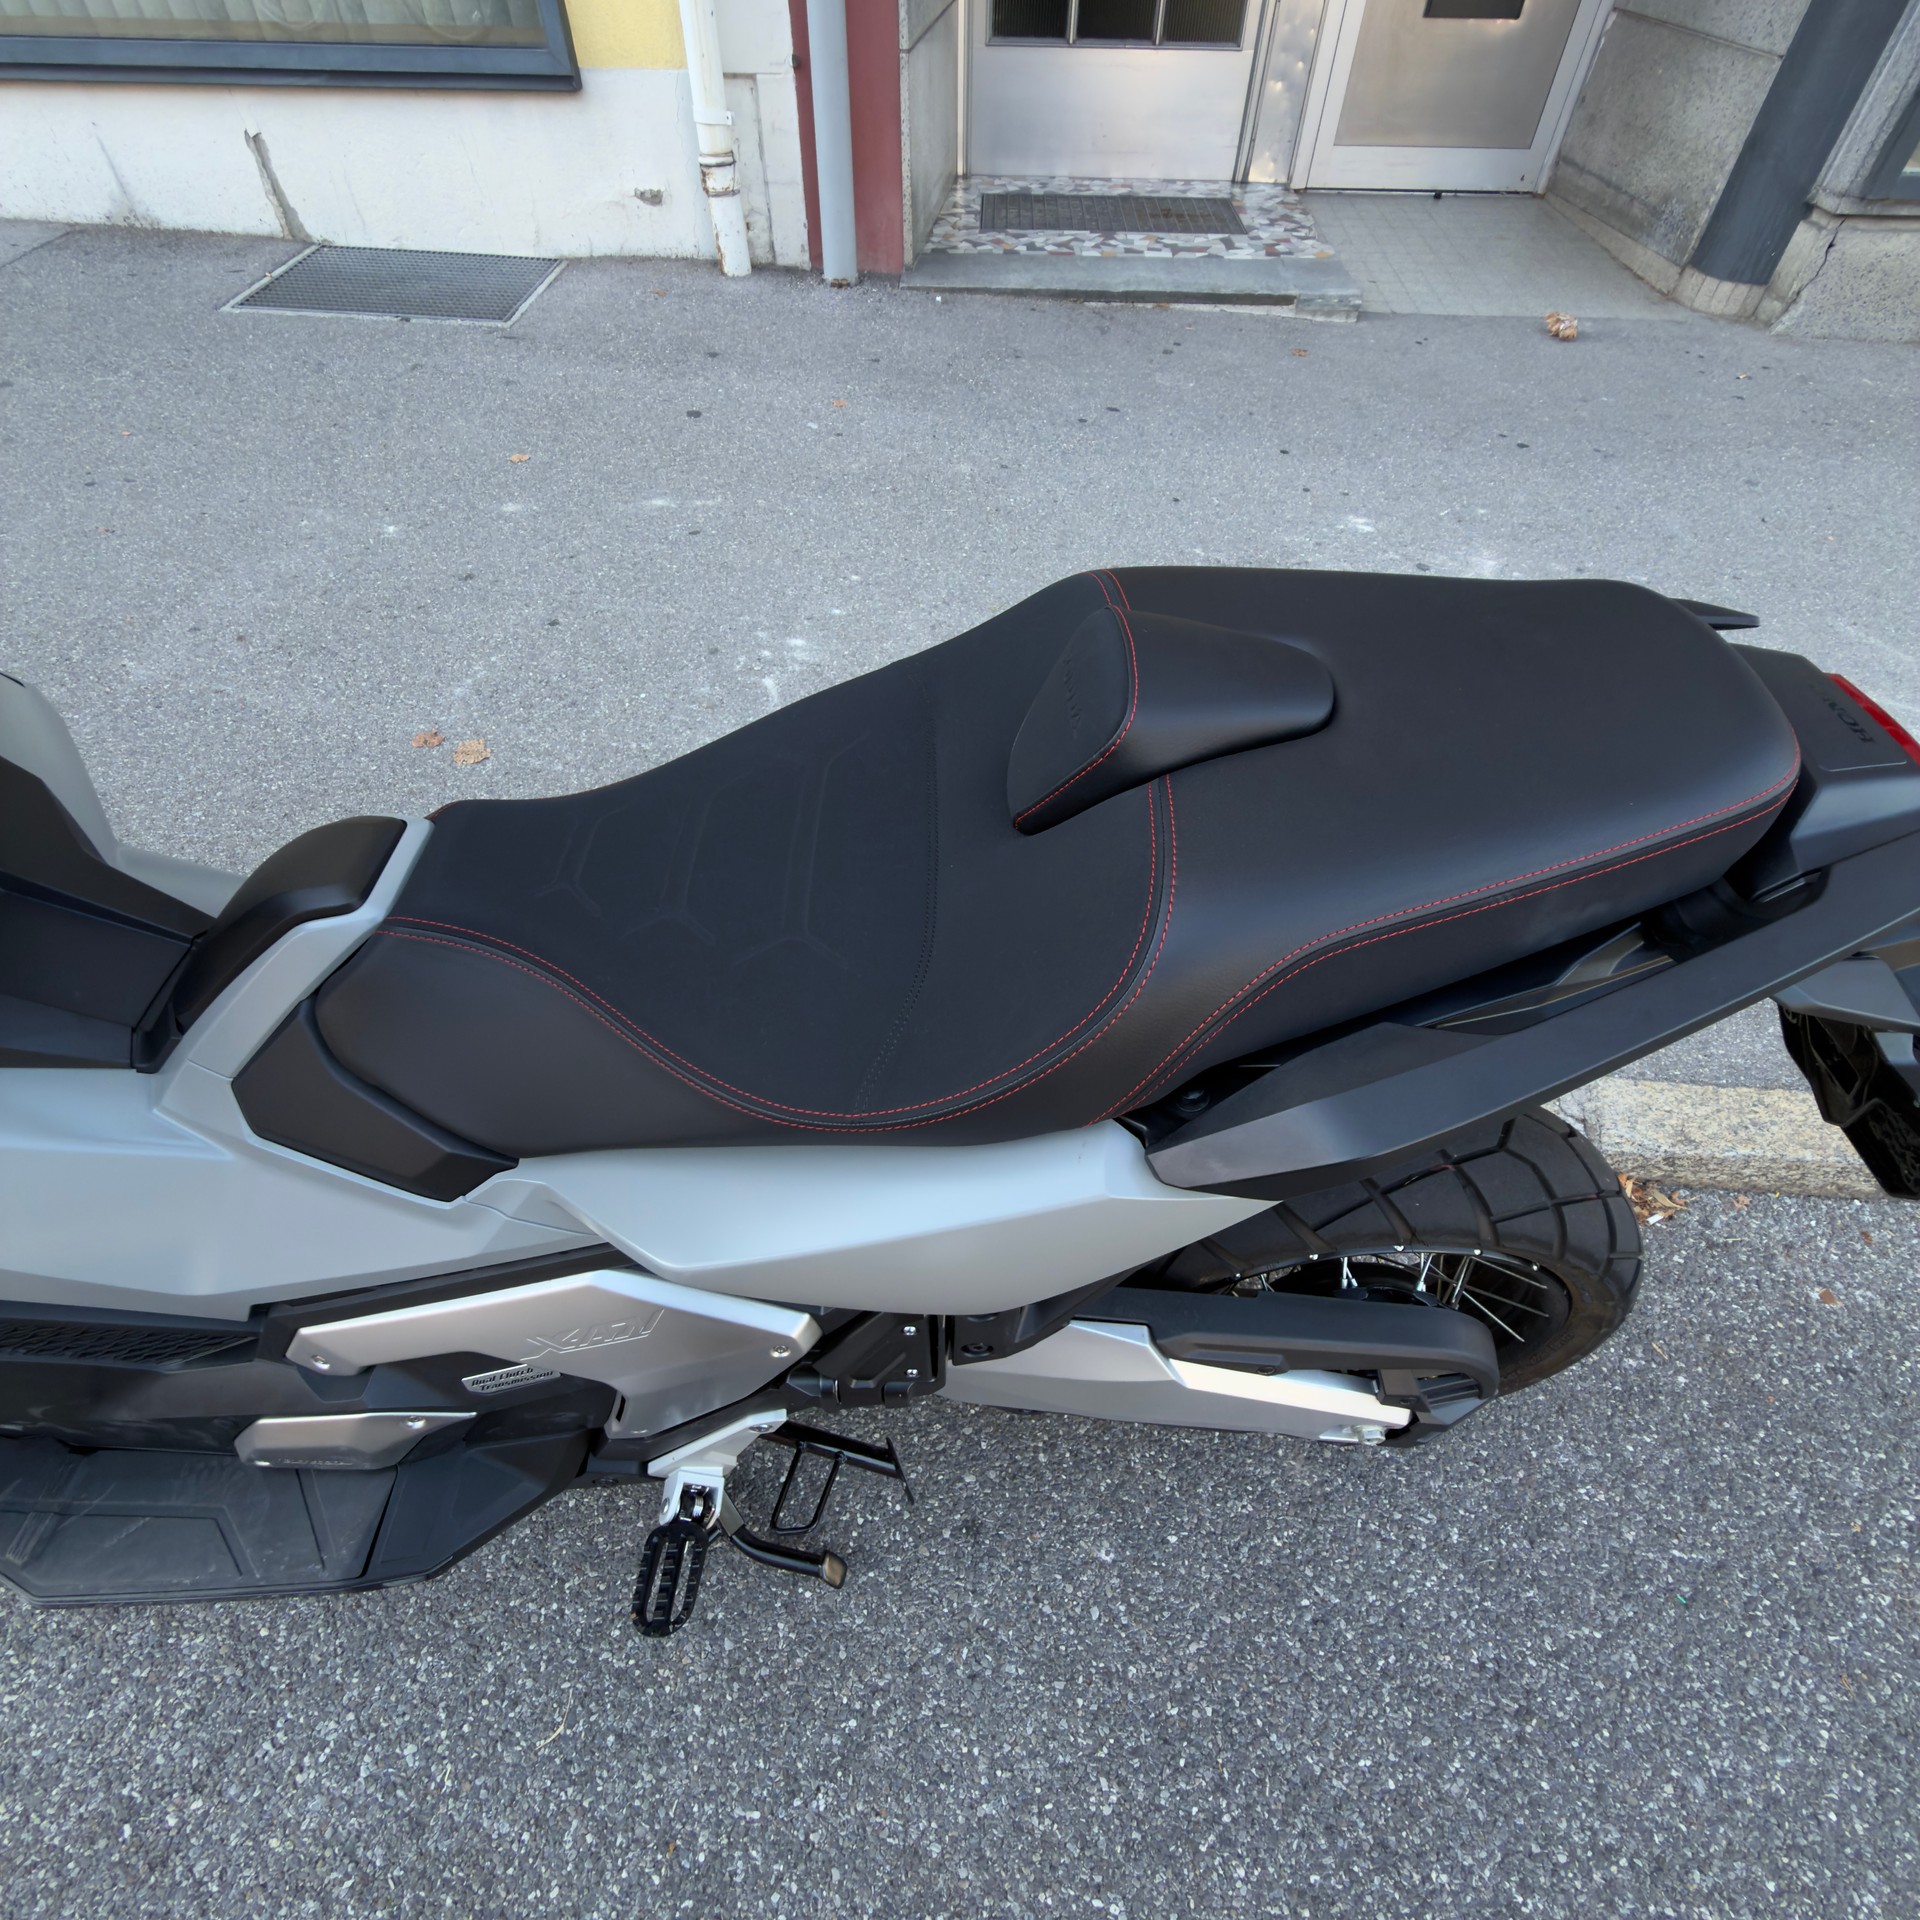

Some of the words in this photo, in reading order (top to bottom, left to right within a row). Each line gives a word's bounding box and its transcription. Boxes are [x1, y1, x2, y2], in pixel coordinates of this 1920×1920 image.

[471, 1375, 496, 1387] Dual
[500, 1367, 534, 1380] Clutch
[480, 1370, 554, 1391] Transmission
